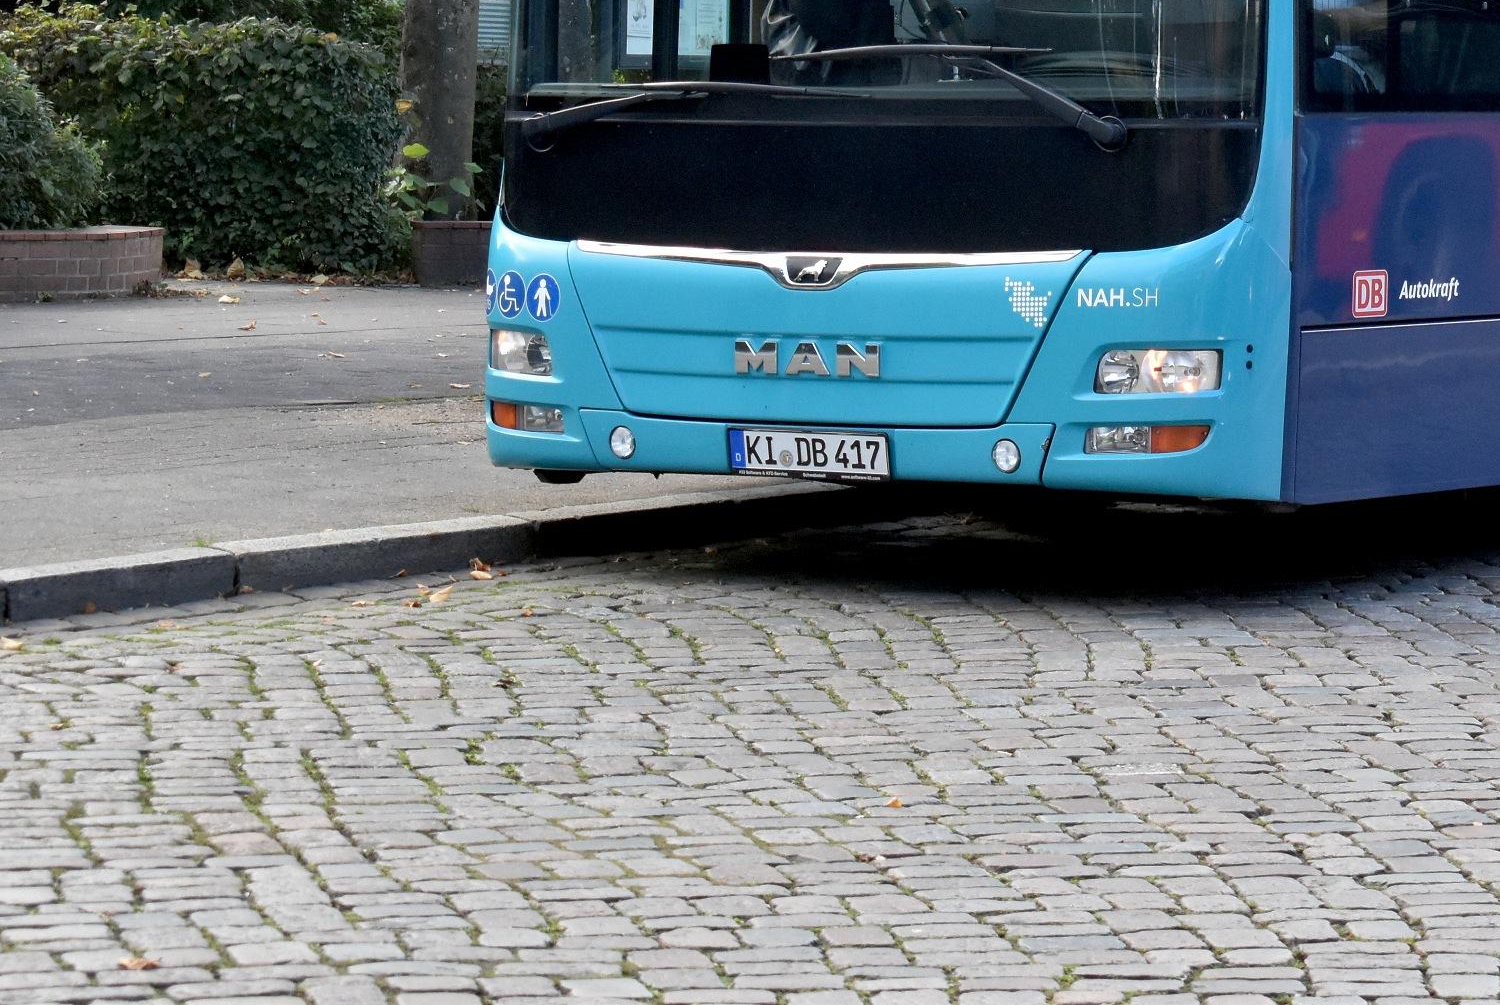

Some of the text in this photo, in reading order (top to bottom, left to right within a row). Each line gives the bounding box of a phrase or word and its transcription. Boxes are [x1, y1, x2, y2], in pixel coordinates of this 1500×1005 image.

[1077, 287, 1158, 308] NAH.SH
[1356, 277, 1460, 310] DB Autokraft
[734, 337, 883, 378] MAN
[735, 452, 742, 462] D
[745, 435, 880, 470] KI DB 417
